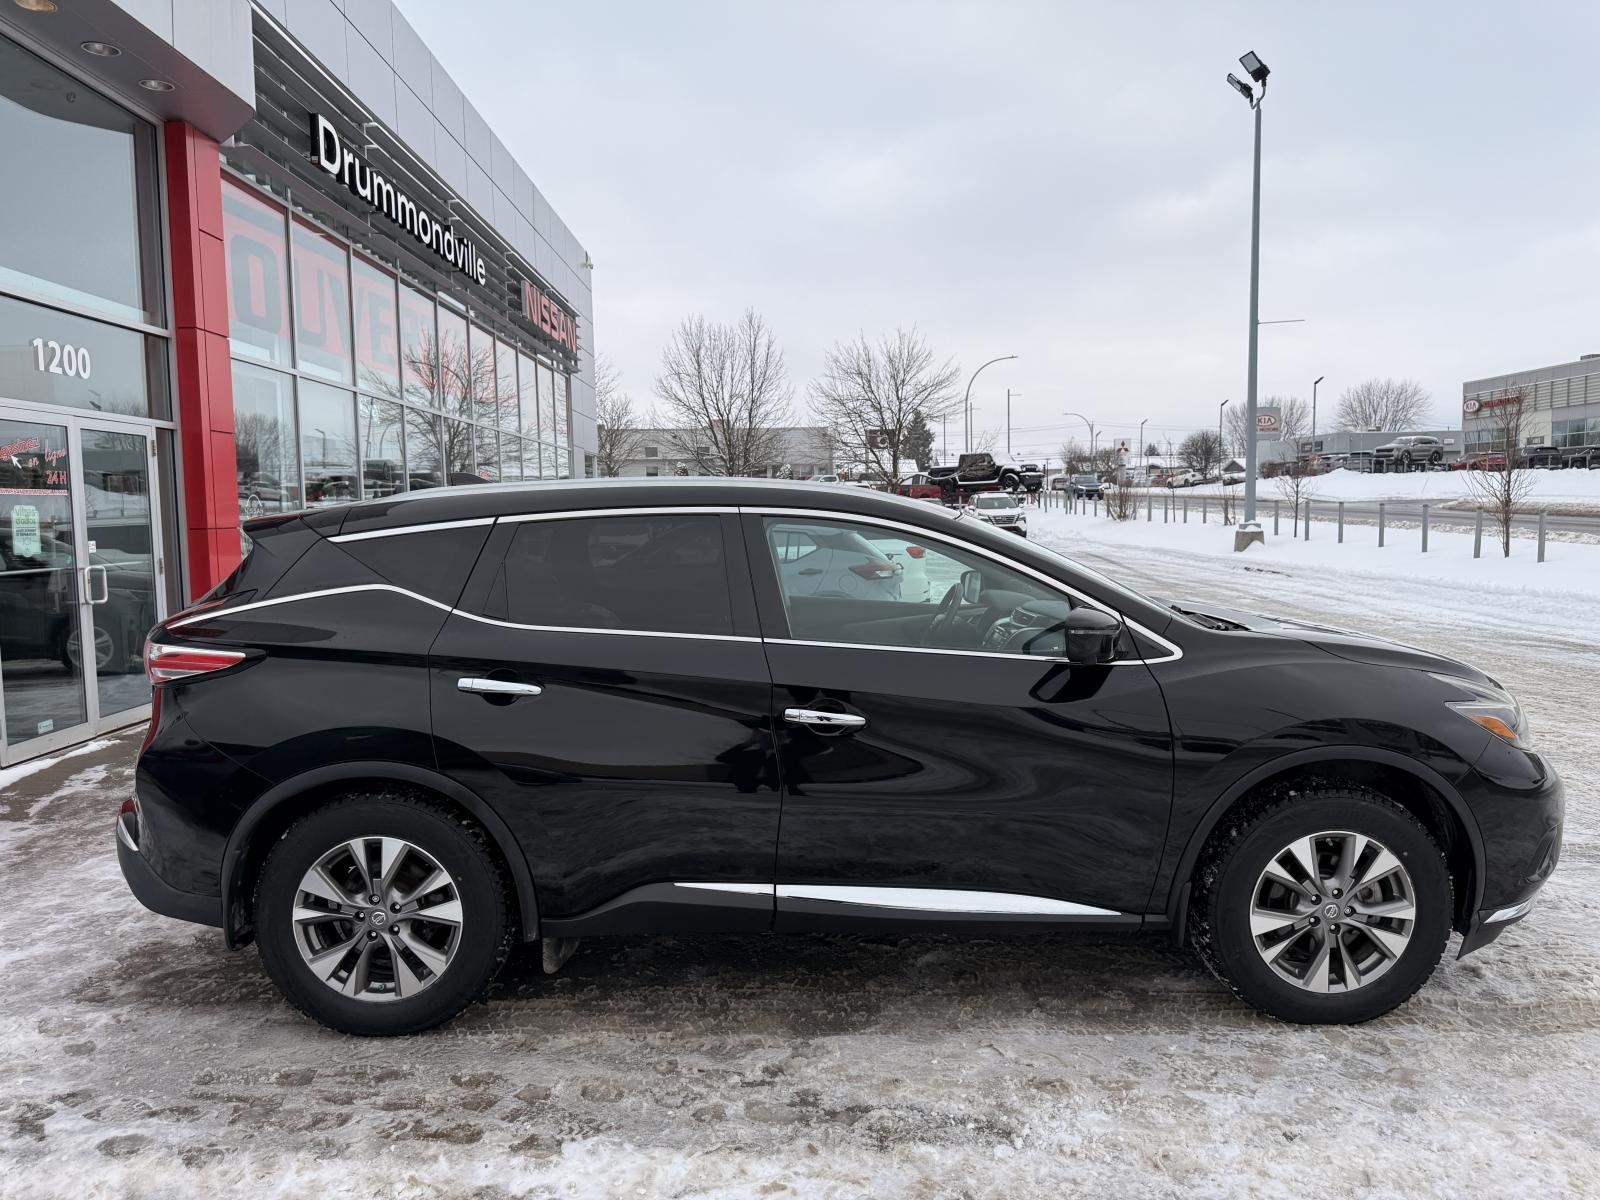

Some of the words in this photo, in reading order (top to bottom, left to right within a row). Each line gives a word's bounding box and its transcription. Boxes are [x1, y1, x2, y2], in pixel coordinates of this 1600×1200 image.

[318, 113, 486, 287] Drummondville
[523, 280, 577, 354] NISSAN
[32, 337, 91, 380] 1200
